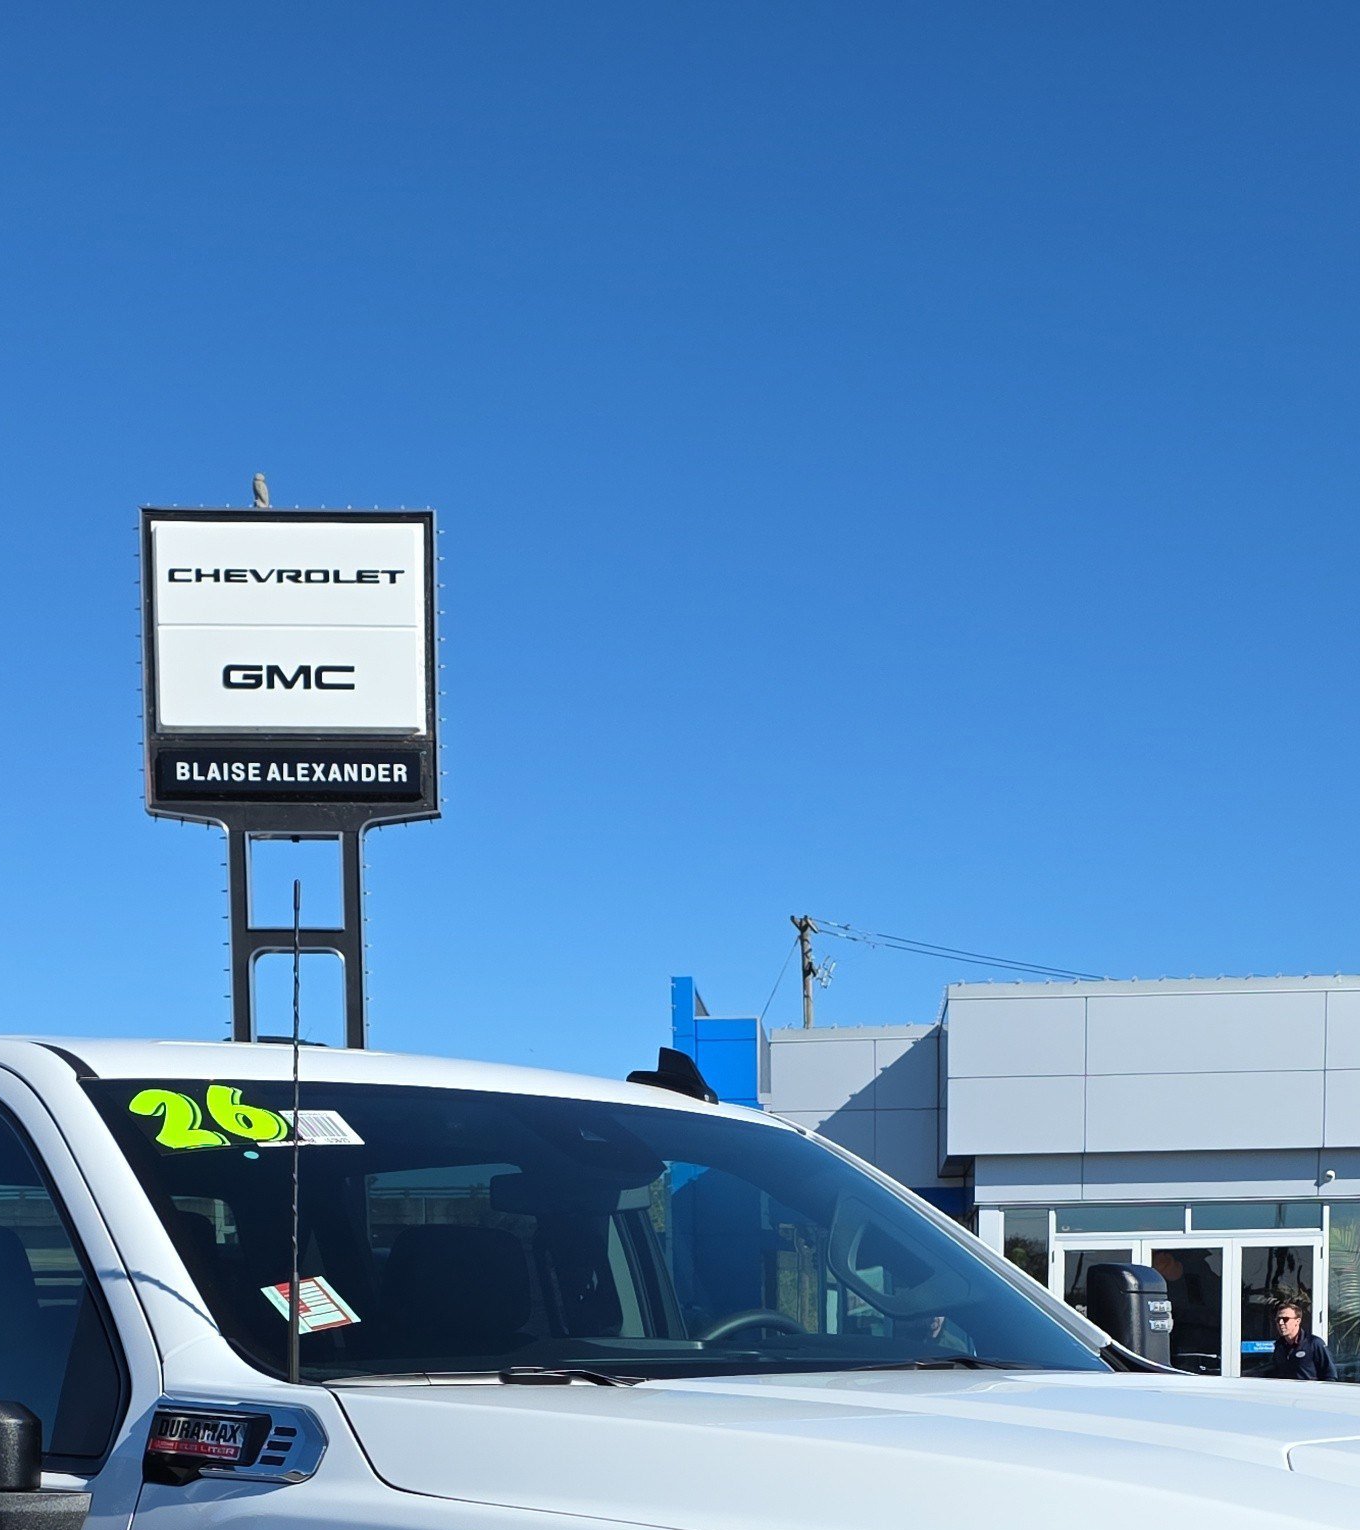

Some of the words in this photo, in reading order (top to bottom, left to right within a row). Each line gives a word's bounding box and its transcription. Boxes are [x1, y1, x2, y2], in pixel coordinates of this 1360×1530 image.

[167, 568, 405, 584] CHEVROLET
[222, 664, 355, 690] GMC
[175, 761, 262, 782] BLAISE
[267, 762, 408, 782] ALEXANDER
[129, 1085, 289, 1150] 26
[158, 1419, 240, 1444] DURAMAX
